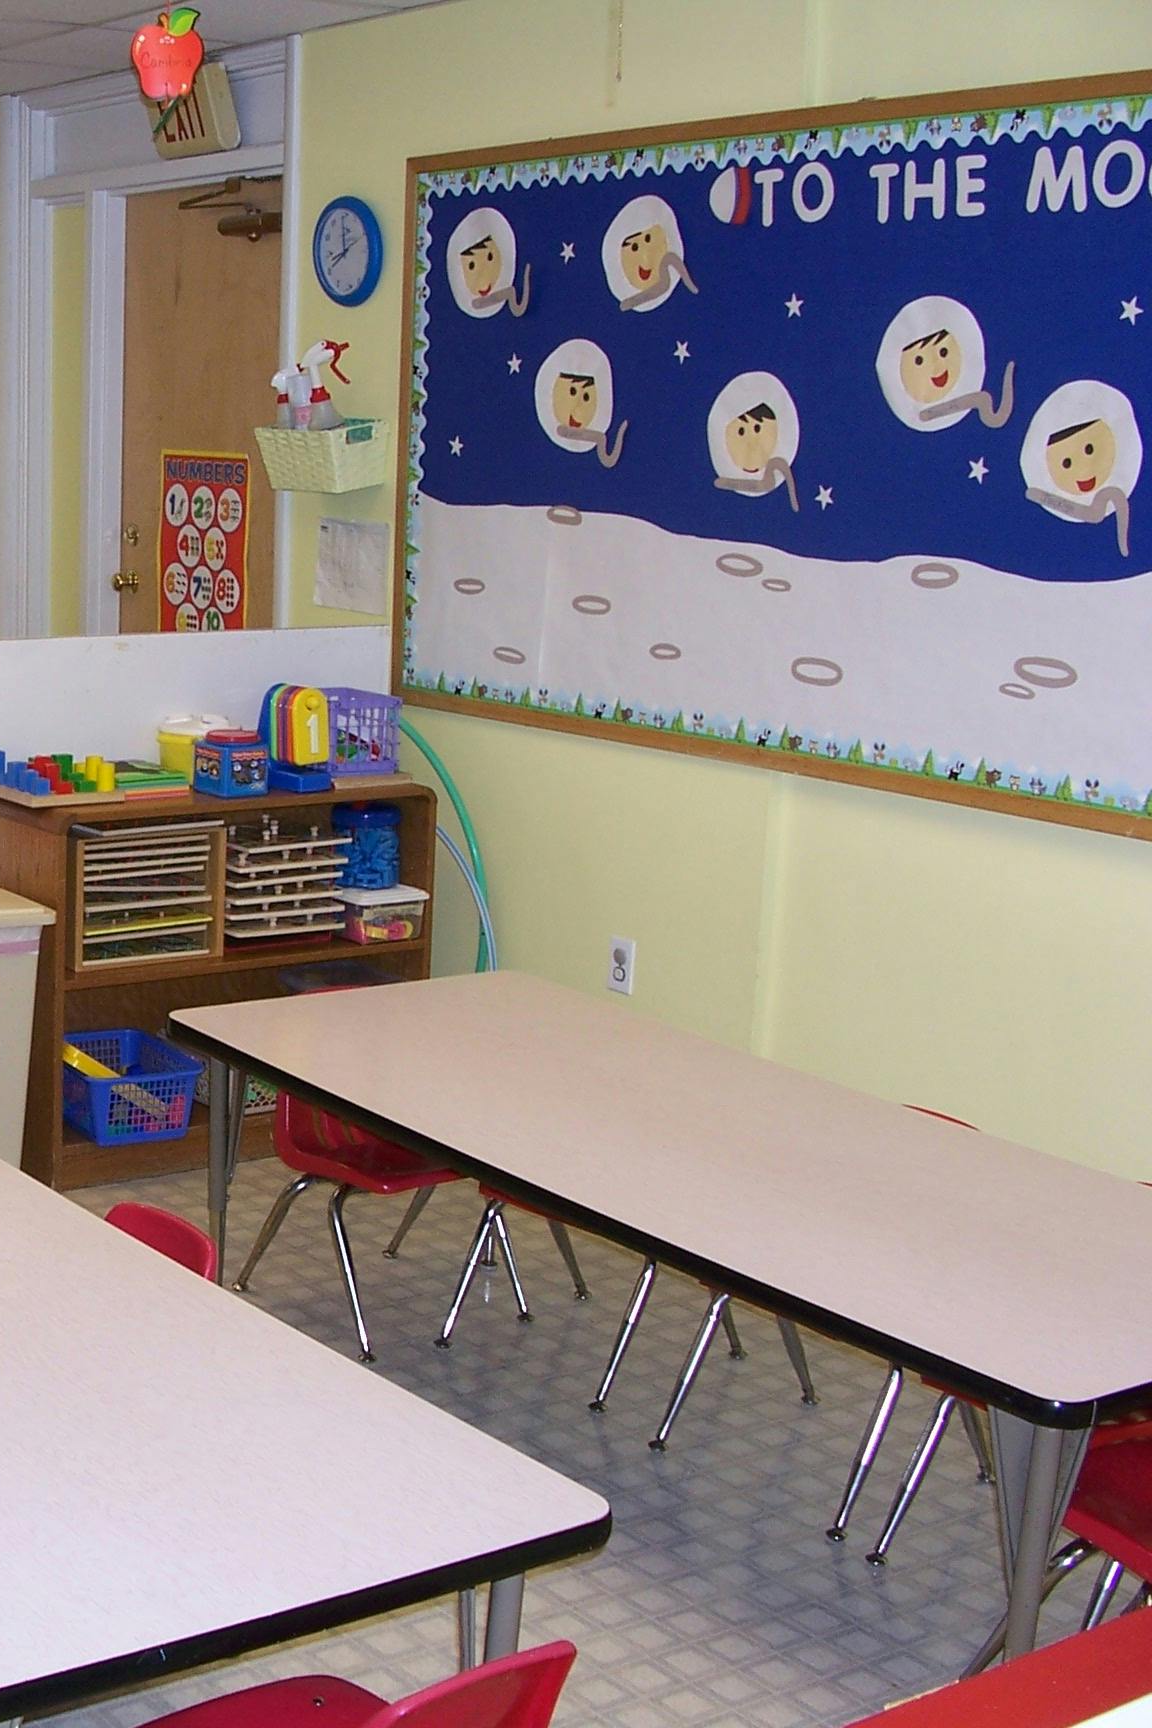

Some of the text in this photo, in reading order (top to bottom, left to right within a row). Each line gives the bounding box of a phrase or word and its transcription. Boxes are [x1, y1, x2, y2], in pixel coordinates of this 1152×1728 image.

[754, 139, 1152, 228] TO THE MO
[166, 458, 245, 485] NUMBERS
[306, 714, 319, 754] 1
